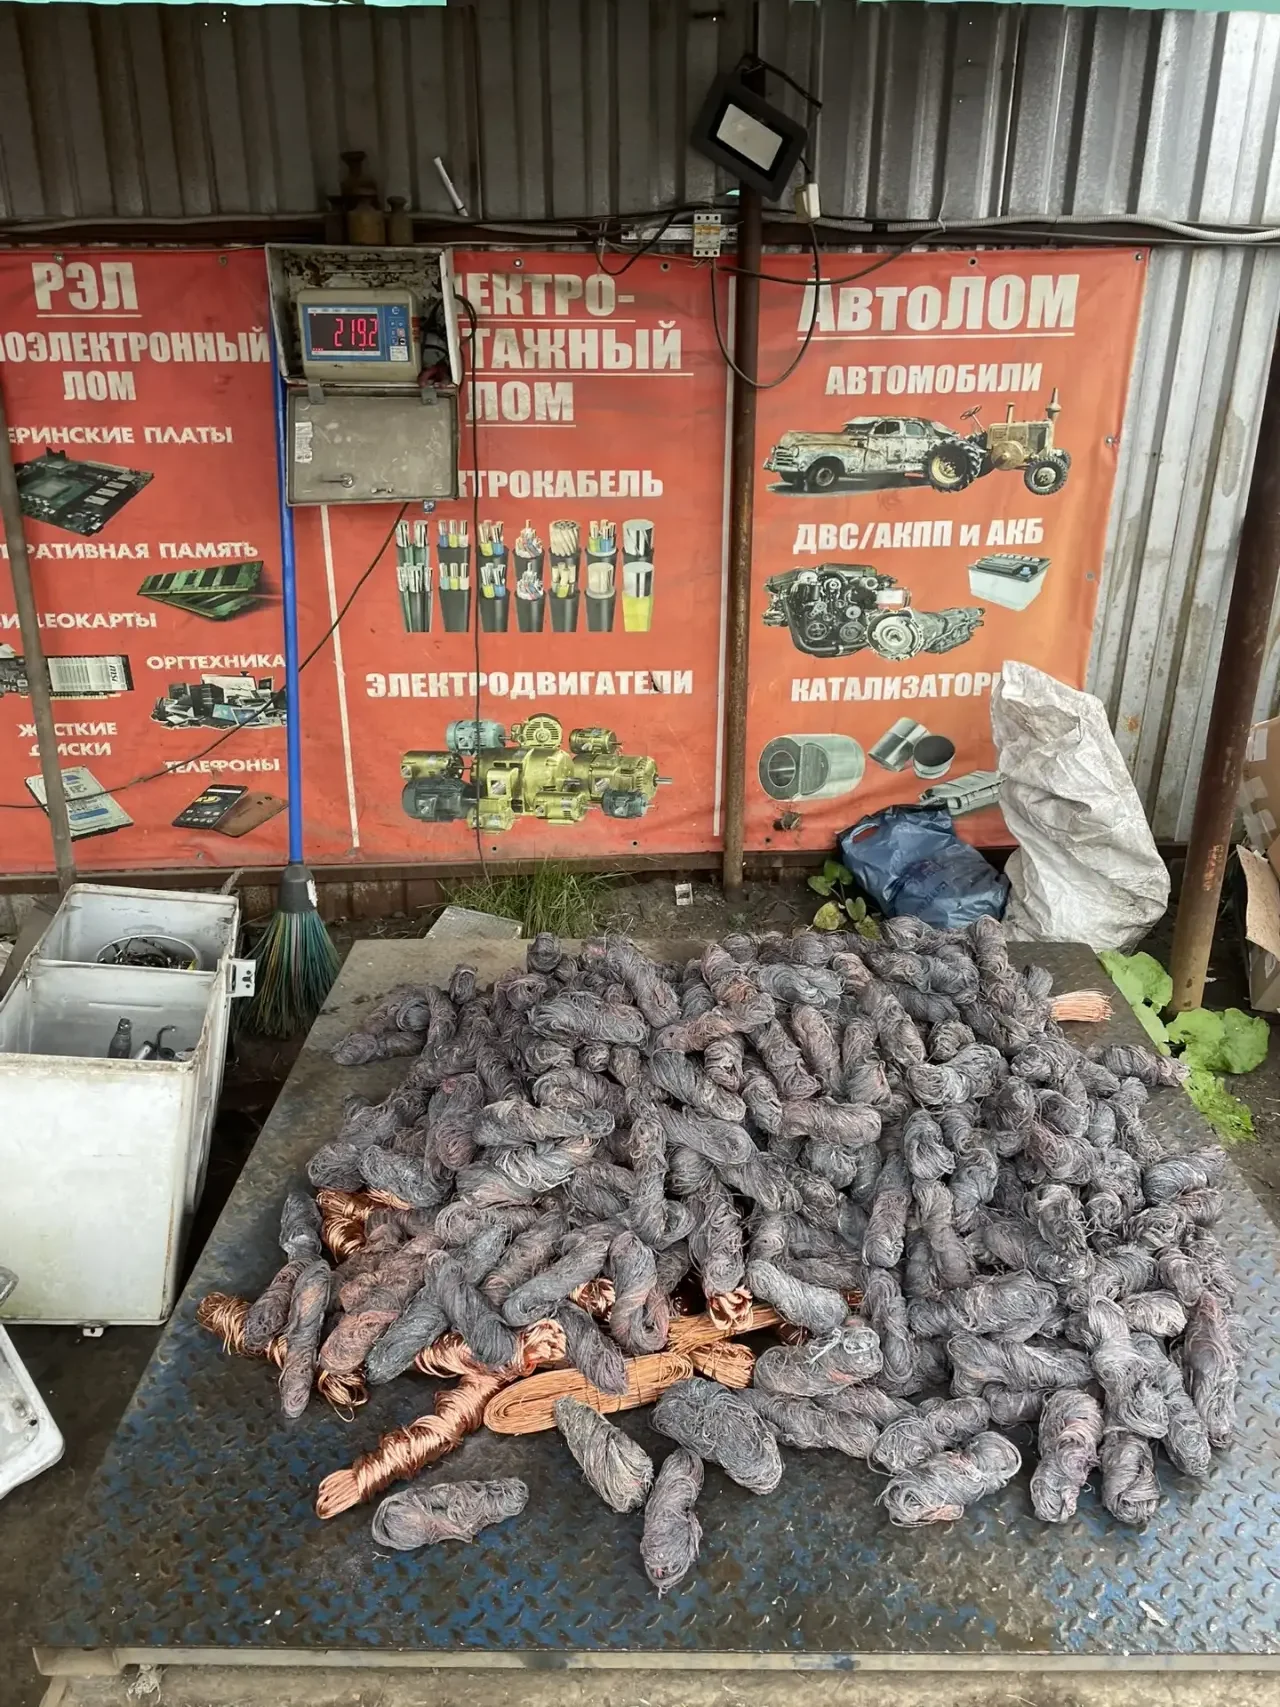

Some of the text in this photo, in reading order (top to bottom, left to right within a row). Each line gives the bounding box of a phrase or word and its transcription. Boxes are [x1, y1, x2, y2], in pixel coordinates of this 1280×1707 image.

[31, 262, 139, 310] РЭЛ
[0, 326, 271, 363] ОЭЛЕКТРОННЫЙ
[462, 320, 682, 370] ТАЖНЫЙ
[63, 371, 137, 401] ЛОМ
[824, 363, 1043, 395] АВТОМОБИЛИ
[465, 381, 574, 421] ЛОМ
[144, 425, 233, 444] ПЛАТЫ
[159, 541, 258, 559] ПАМЯТЬ
[793, 518, 1044, 554] ДВС/АКПП и АКБ
[0, 613, 157, 629] ИЕОКАРТЫ
[146, 654, 286, 671] ОРГТЕХНИКА
[365, 669, 693, 699] ЭЛЕКТРОДВИГАТЕЛИ
[17, 722, 118, 737] ЖСТКИЕ
[163, 758, 280, 774] ТЕЛЕФОНЫ
